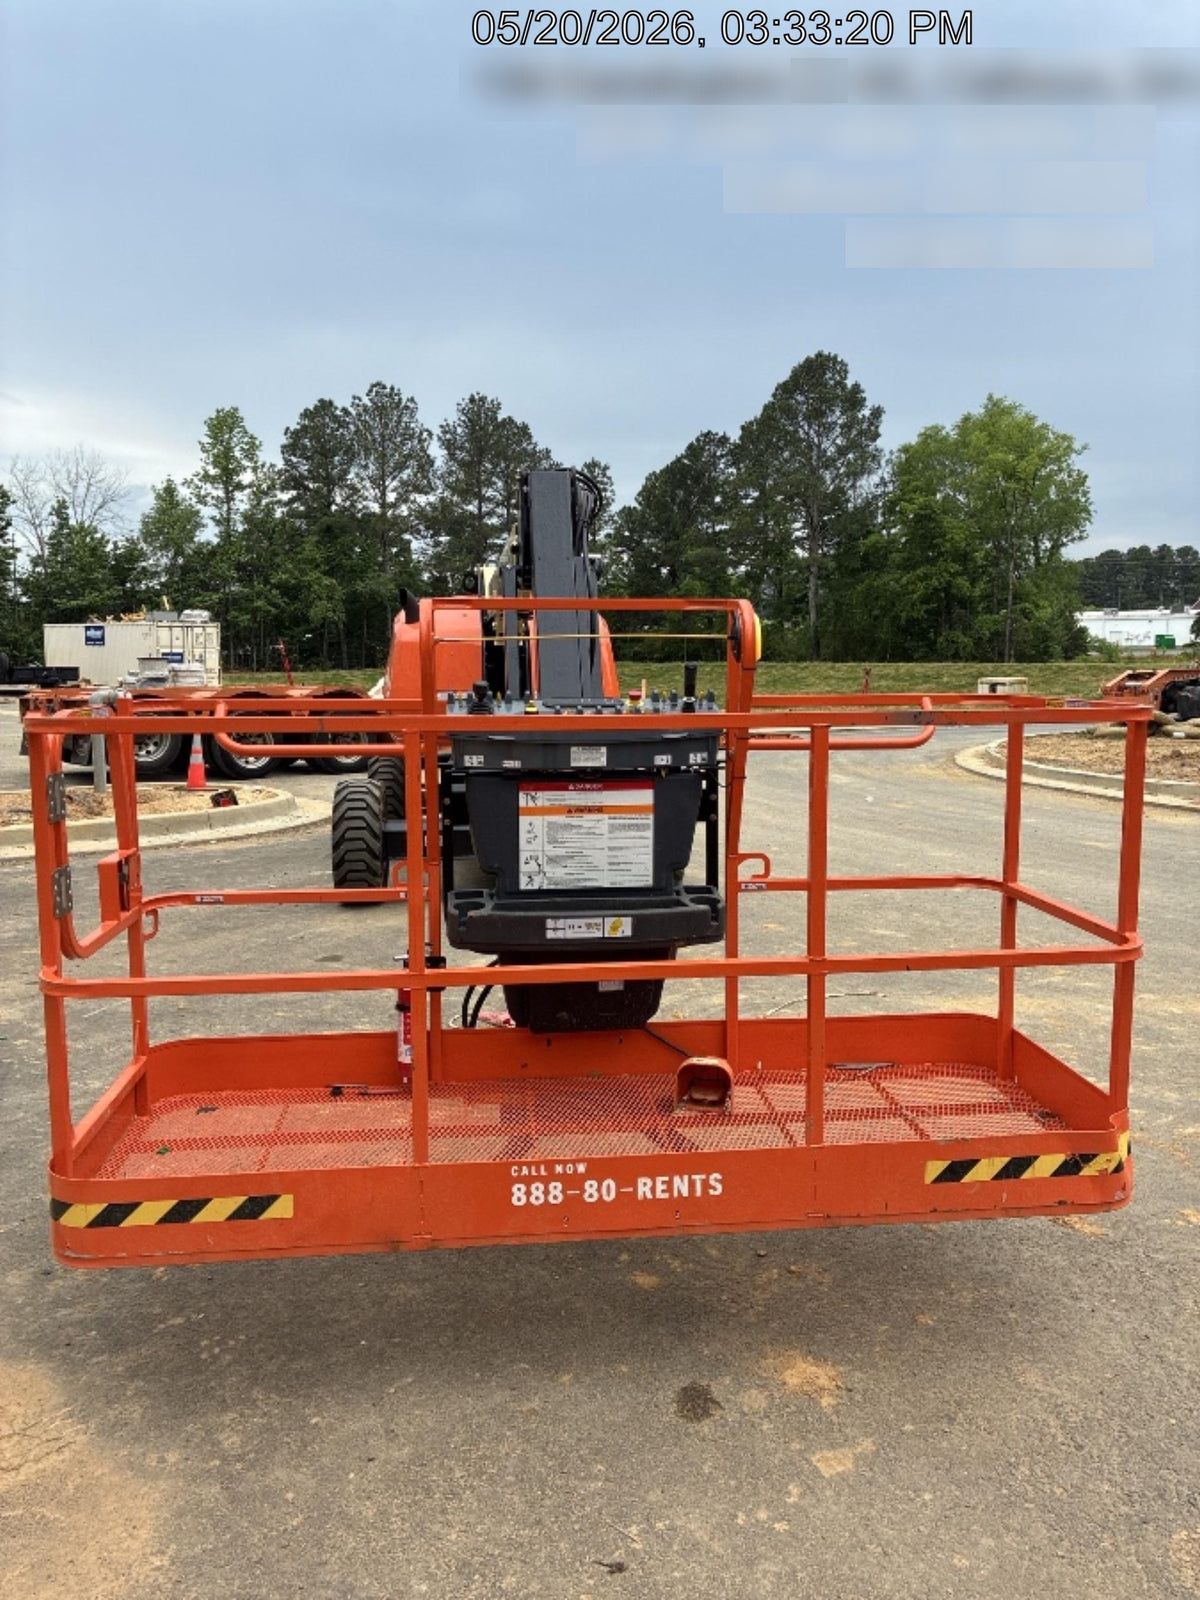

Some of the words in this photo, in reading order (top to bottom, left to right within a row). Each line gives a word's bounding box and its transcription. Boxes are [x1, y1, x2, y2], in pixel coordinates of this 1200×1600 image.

[511, 1164, 548, 1177] CALL
[554, 1162, 587, 1175] NOW
[511, 1172, 723, 1207] 888-80-RENTS
